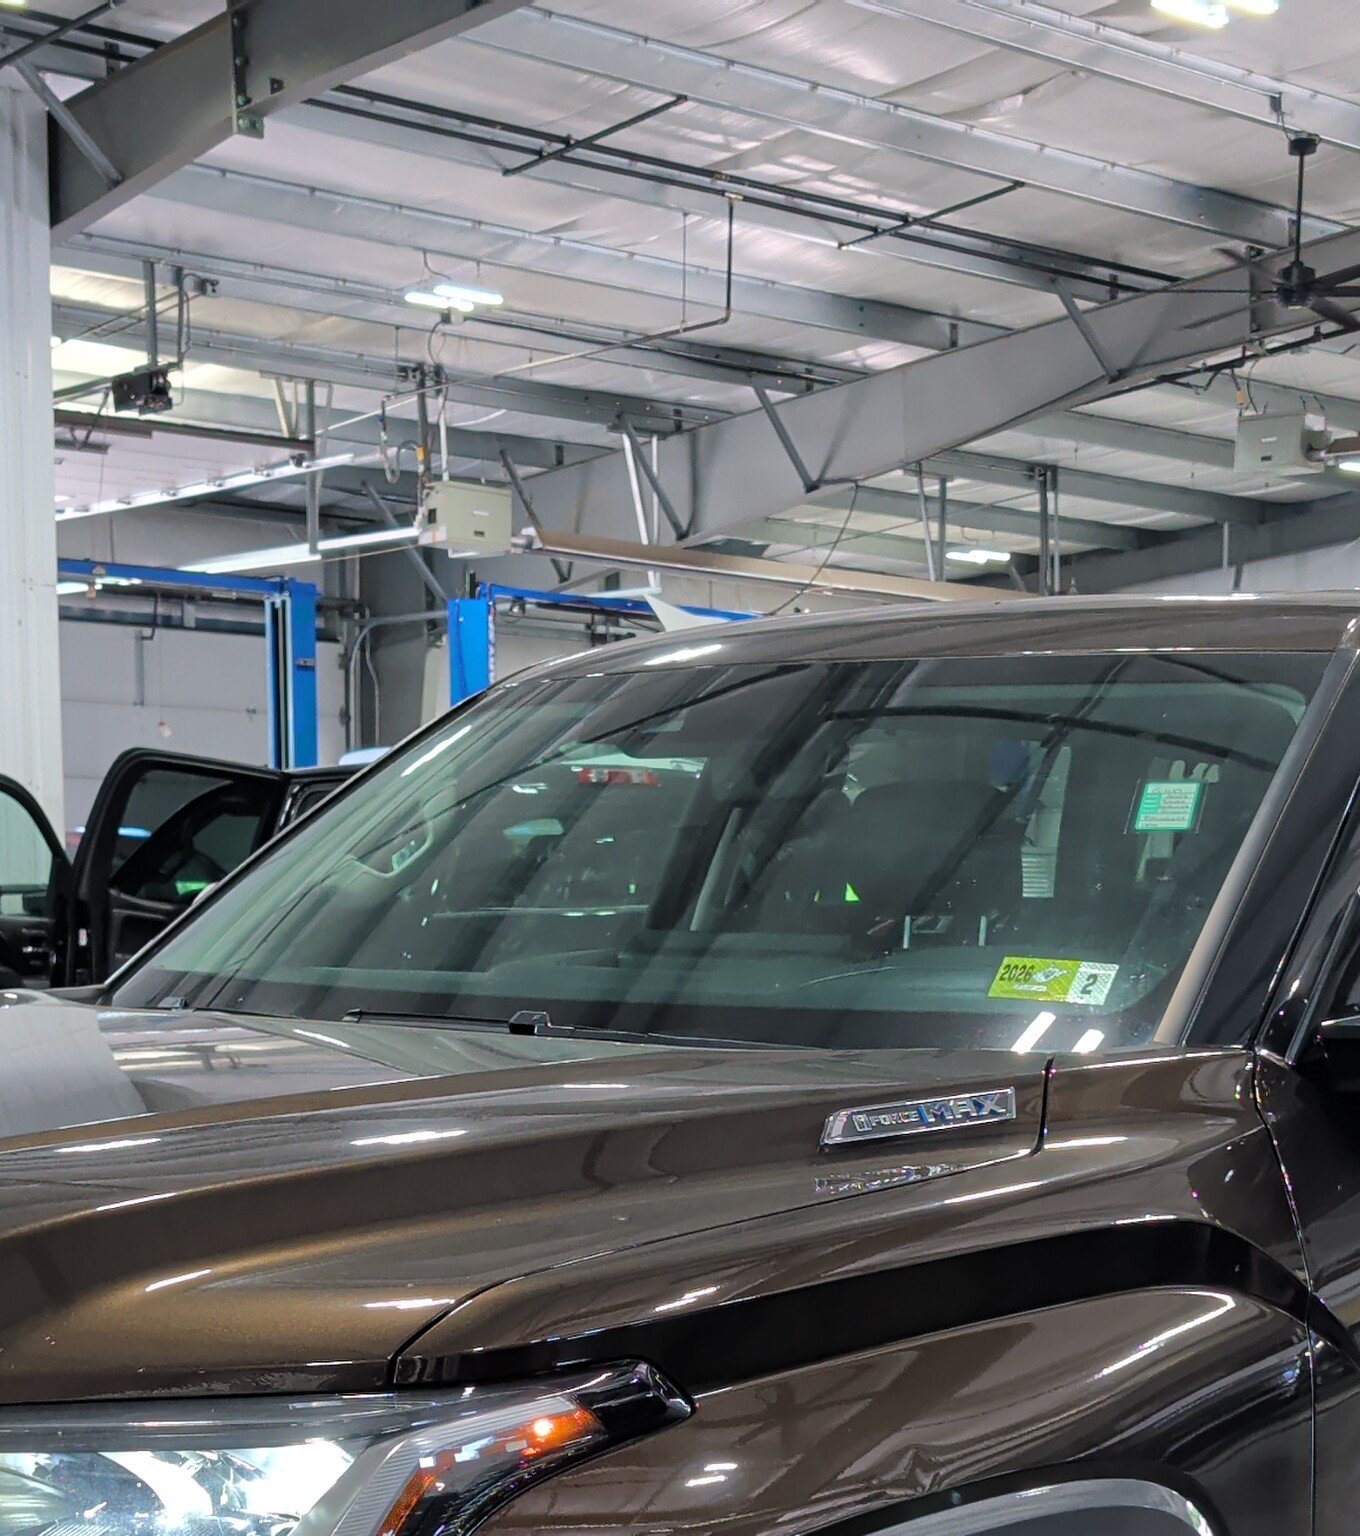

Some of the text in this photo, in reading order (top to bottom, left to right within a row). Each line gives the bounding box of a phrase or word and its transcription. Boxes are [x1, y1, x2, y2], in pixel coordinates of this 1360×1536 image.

[999, 964, 1036, 982] 2026
[1080, 973, 1098, 995] 2
[921, 1094, 1006, 1123] MAX
